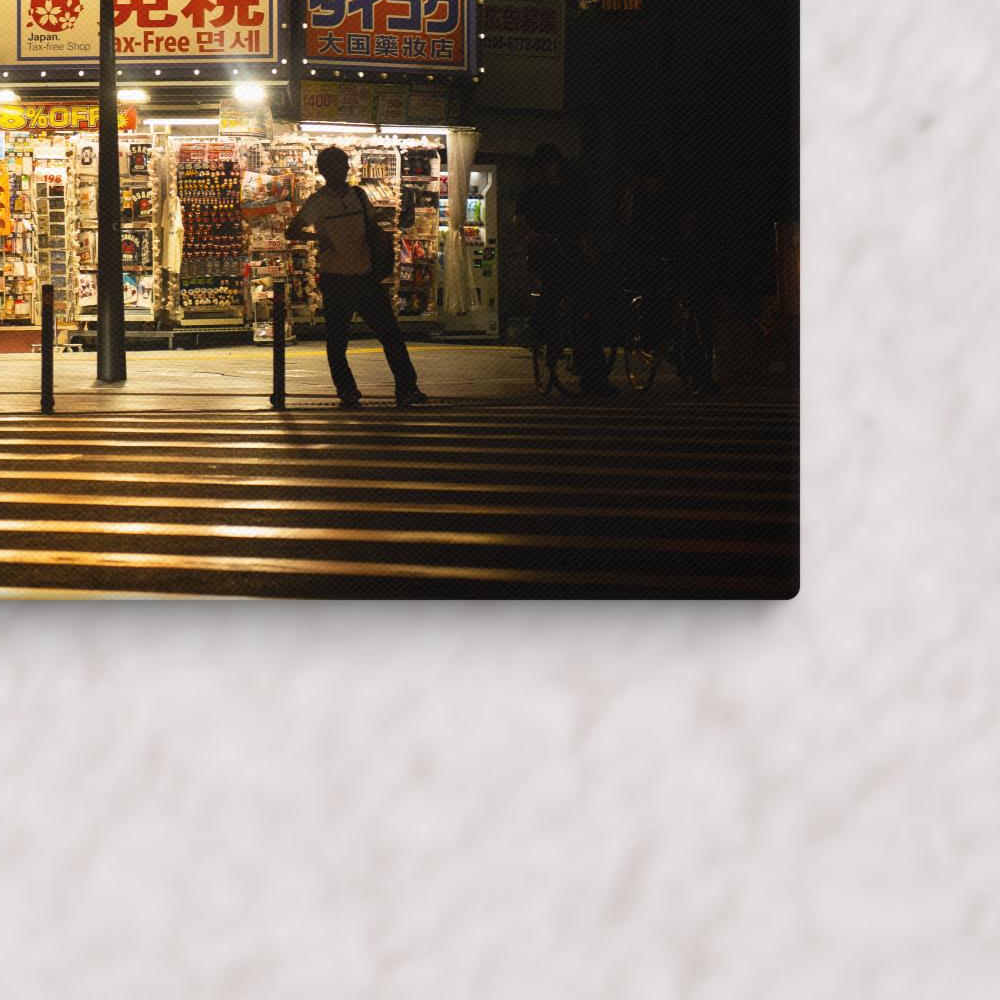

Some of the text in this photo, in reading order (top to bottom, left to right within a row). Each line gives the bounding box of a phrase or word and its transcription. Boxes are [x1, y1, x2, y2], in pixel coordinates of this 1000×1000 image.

[27, 32, 61, 47] Japan.
[97, 29, 261, 54] ax-Free 면세
[317, 30, 456, 61] 大国藥妝店
[27, 43, 92, 59] Tax-free Shop
